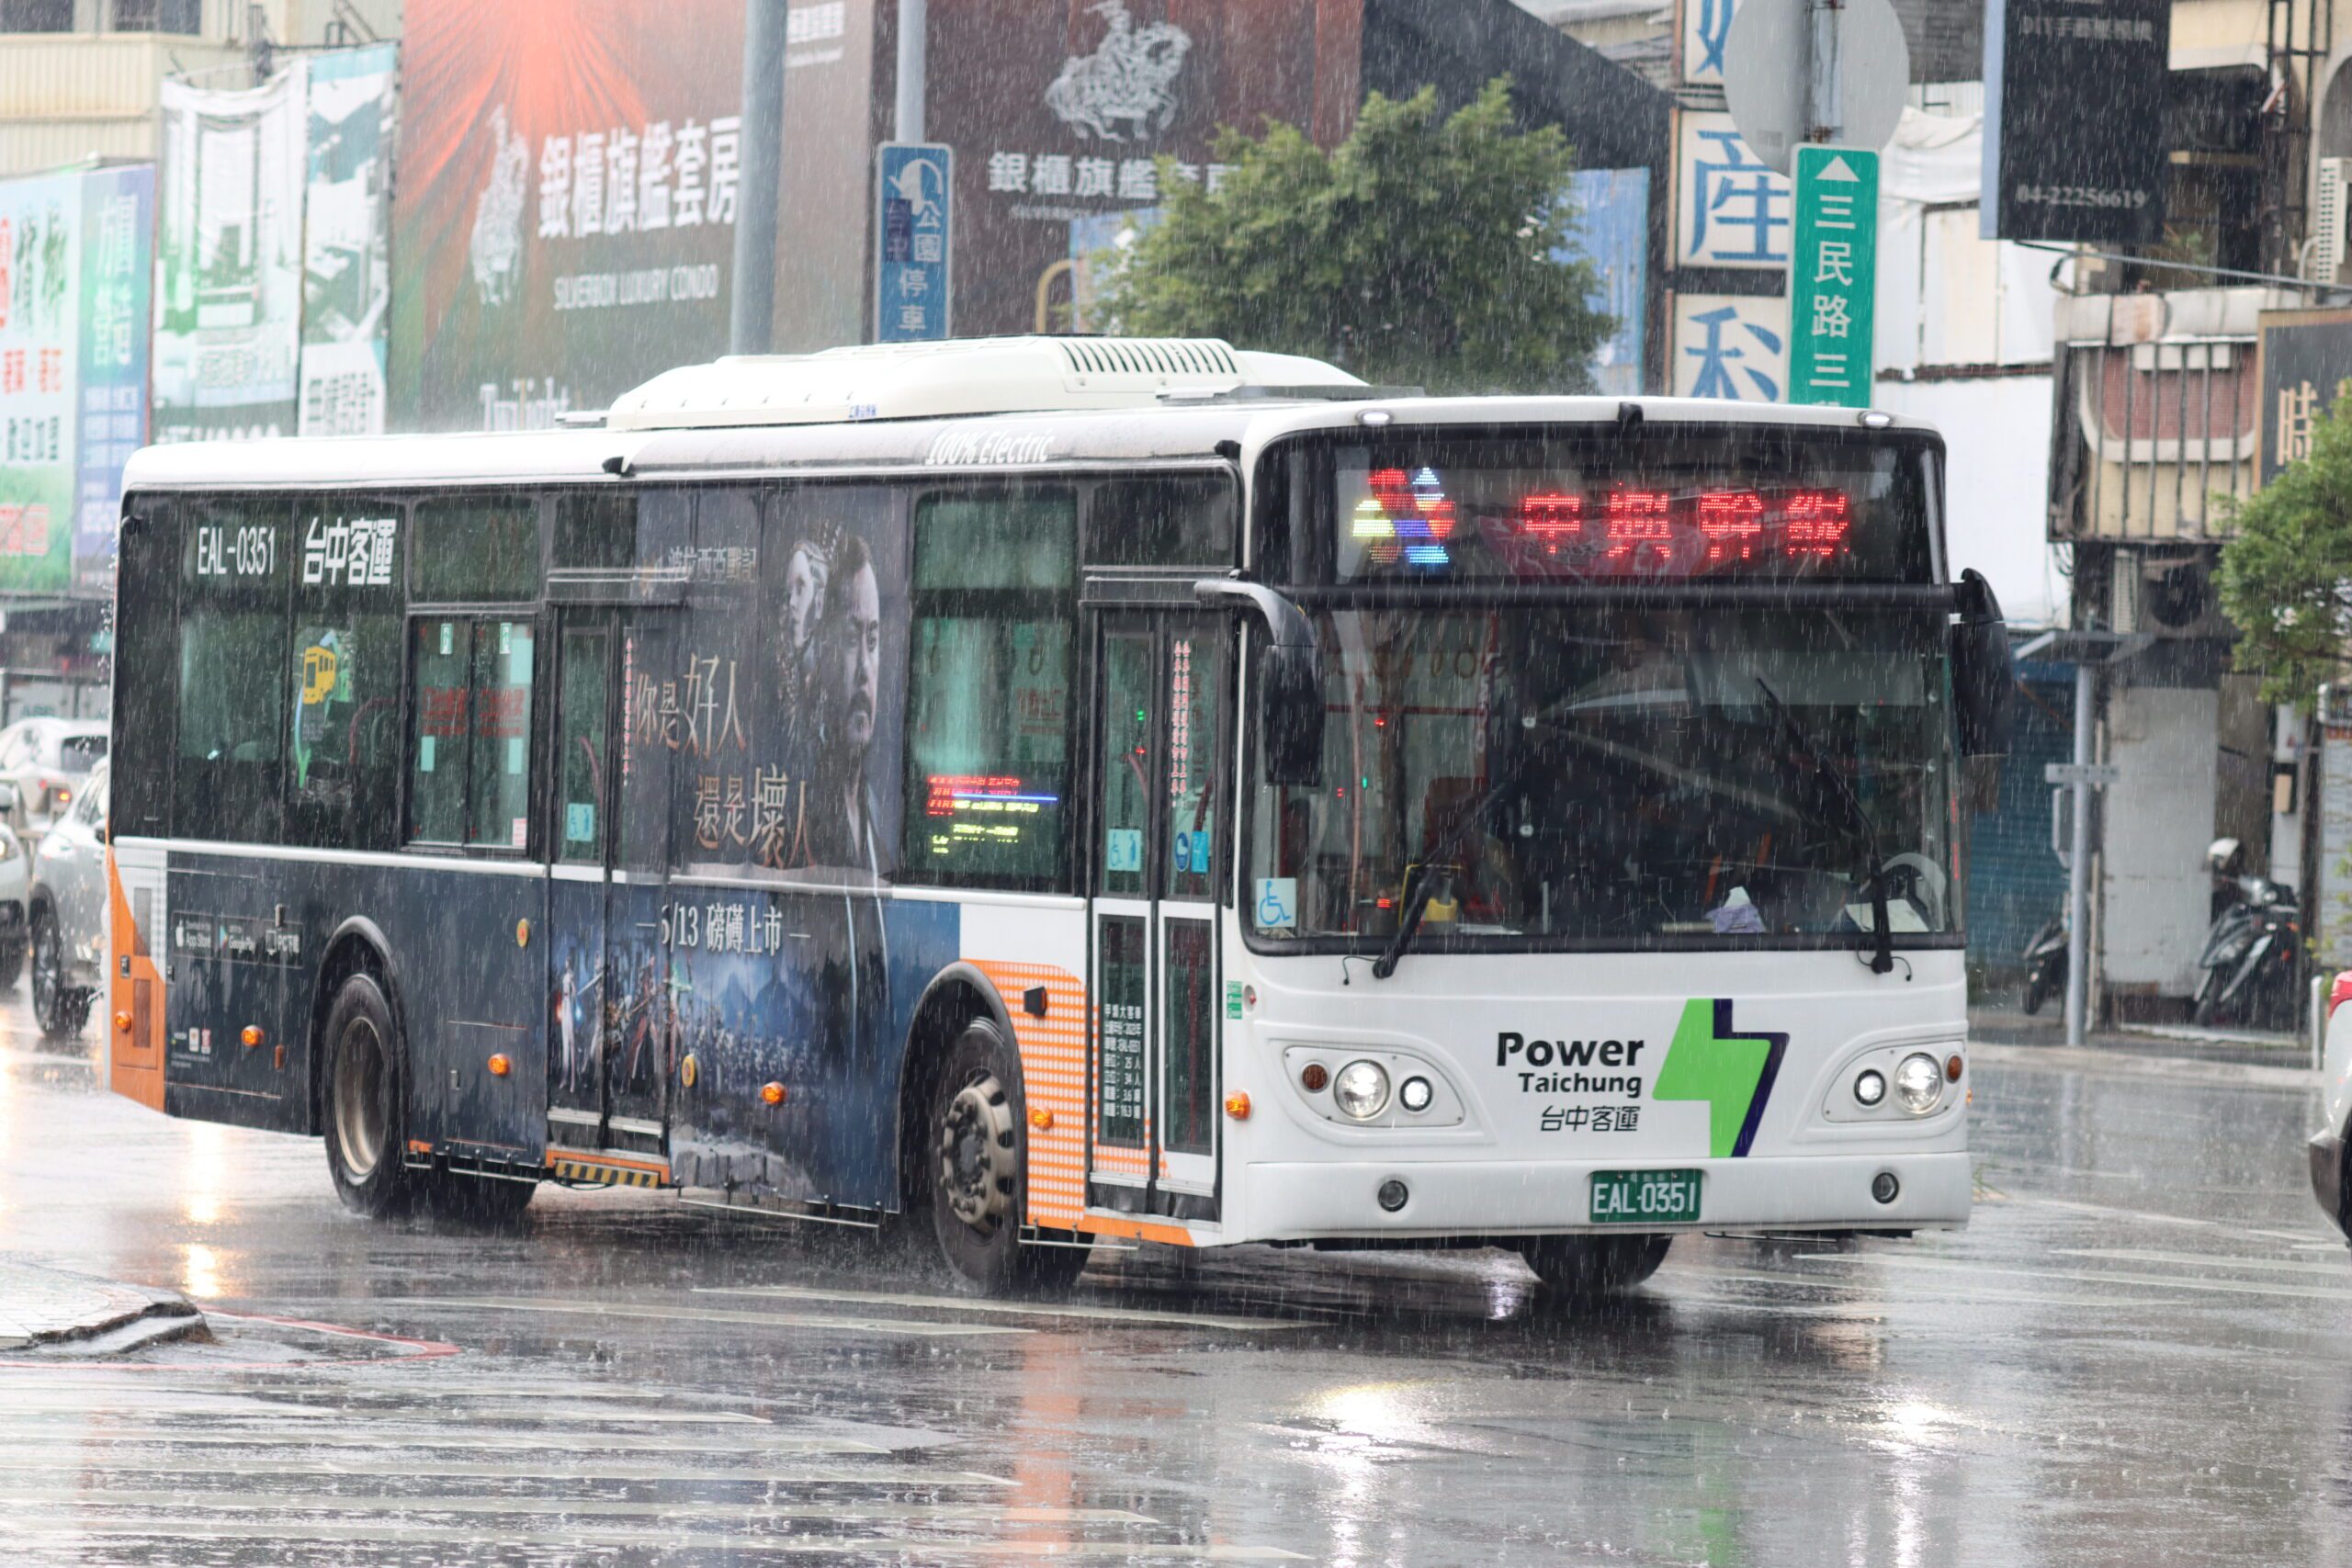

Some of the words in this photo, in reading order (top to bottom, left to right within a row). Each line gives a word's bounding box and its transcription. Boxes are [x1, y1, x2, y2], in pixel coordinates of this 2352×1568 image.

[1809, 194, 1856, 406] 三民路三
[925, 430, 986, 466] 100%
[978, 427, 1055, 465] Electric
[197, 526, 276, 575] EAL-0351
[303, 516, 397, 585] 台中客運
[634, 653, 747, 760] 你是好人
[694, 763, 816, 870] 還是壞人
[1497, 1032, 1645, 1066] Power
[1518, 1072, 1642, 1099] Taichung
[1540, 1105, 1641, 1132] 台中客運
